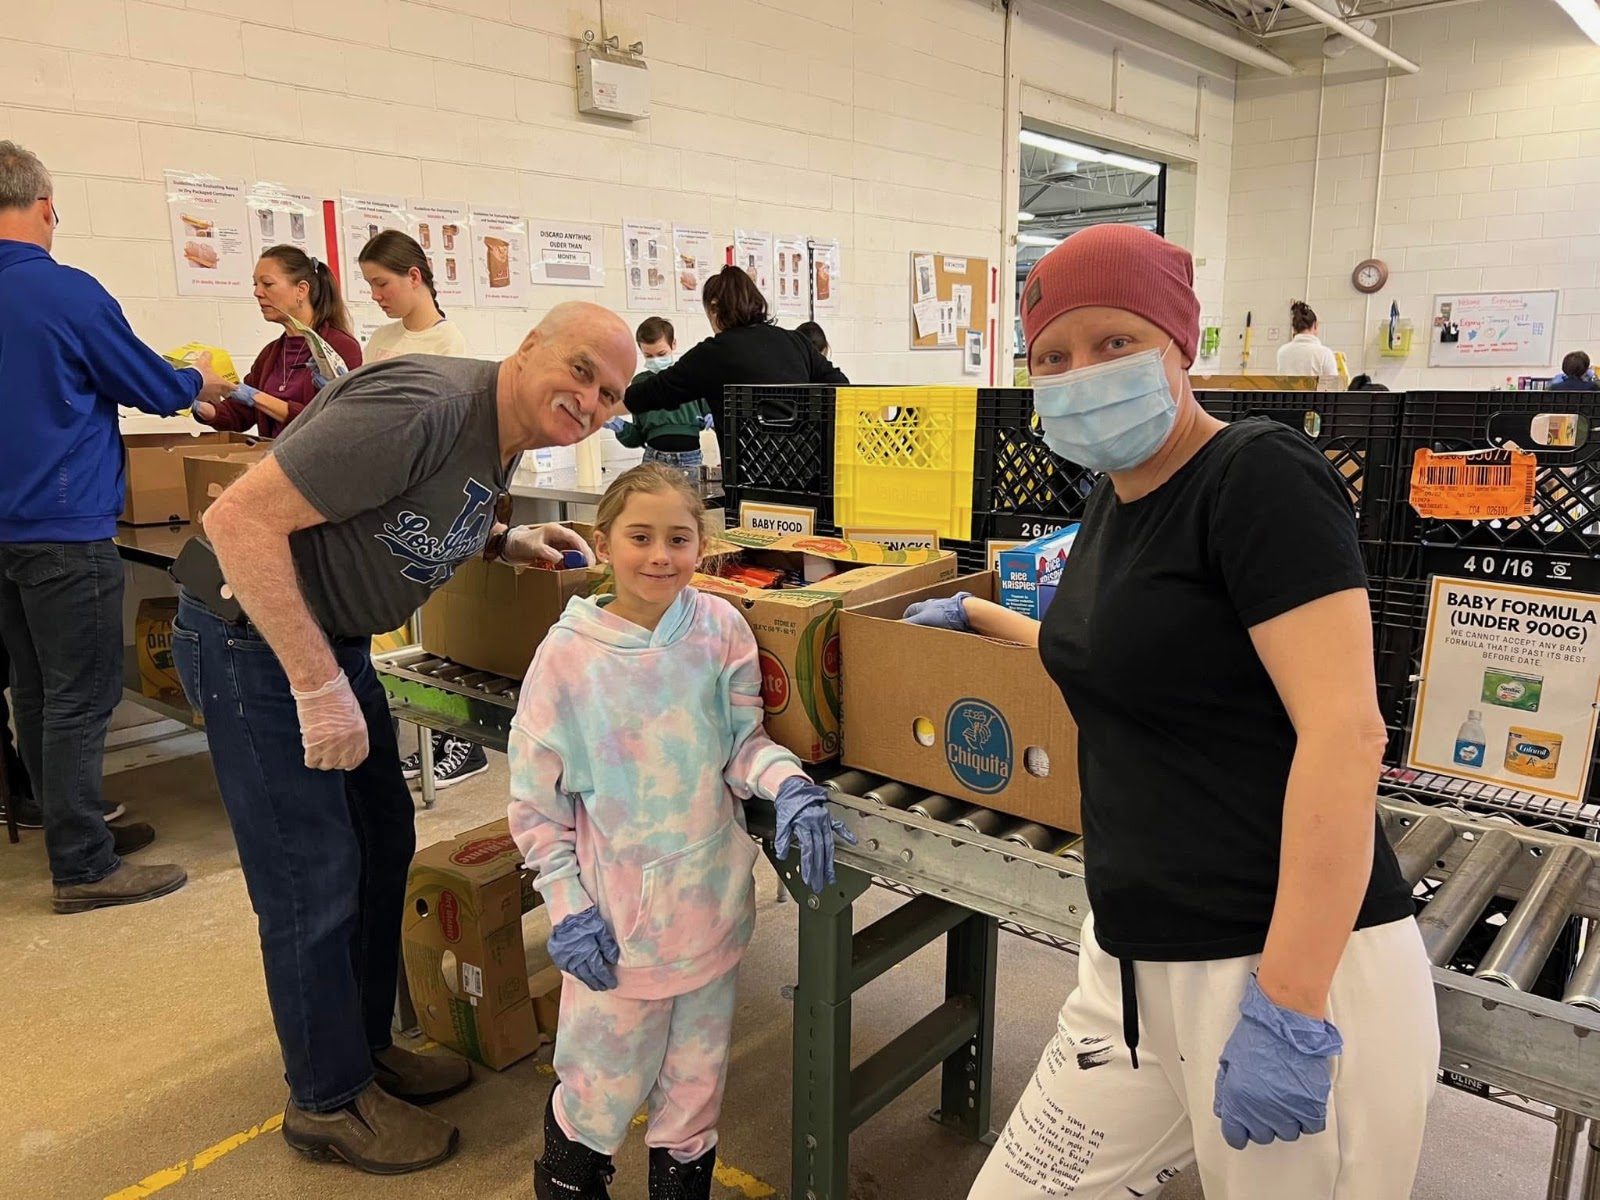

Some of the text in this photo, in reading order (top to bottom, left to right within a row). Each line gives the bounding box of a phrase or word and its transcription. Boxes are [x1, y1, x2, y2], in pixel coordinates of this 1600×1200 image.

[540, 230, 592, 242] DISCARD ANYTHING
[549, 241, 583, 250] OLDER THAN
[752, 518, 803, 533] BABY FOOD
[1447, 592, 1597, 625] BABY FORMULA
[774, 619, 790, 628] STORE
[1450, 610, 1589, 646] (UNDER 900G)
[1450, 628, 1584, 654] WE CANNOT ACCEPT ANY BABY
[1445, 637, 1587, 664] FORMULA THAT IS PAST ITS BEST
[1482, 651, 1515, 663] BEFORE
[947, 742, 1009, 779] Chiquita
[1450, 1072, 1483, 1091] ULINE
[1067, 1115, 1087, 1131] thats
[1091, 1128, 1105, 1140] but
[1066, 1140, 1083, 1153] how
[551, 1176, 582, 1192] SOREL
